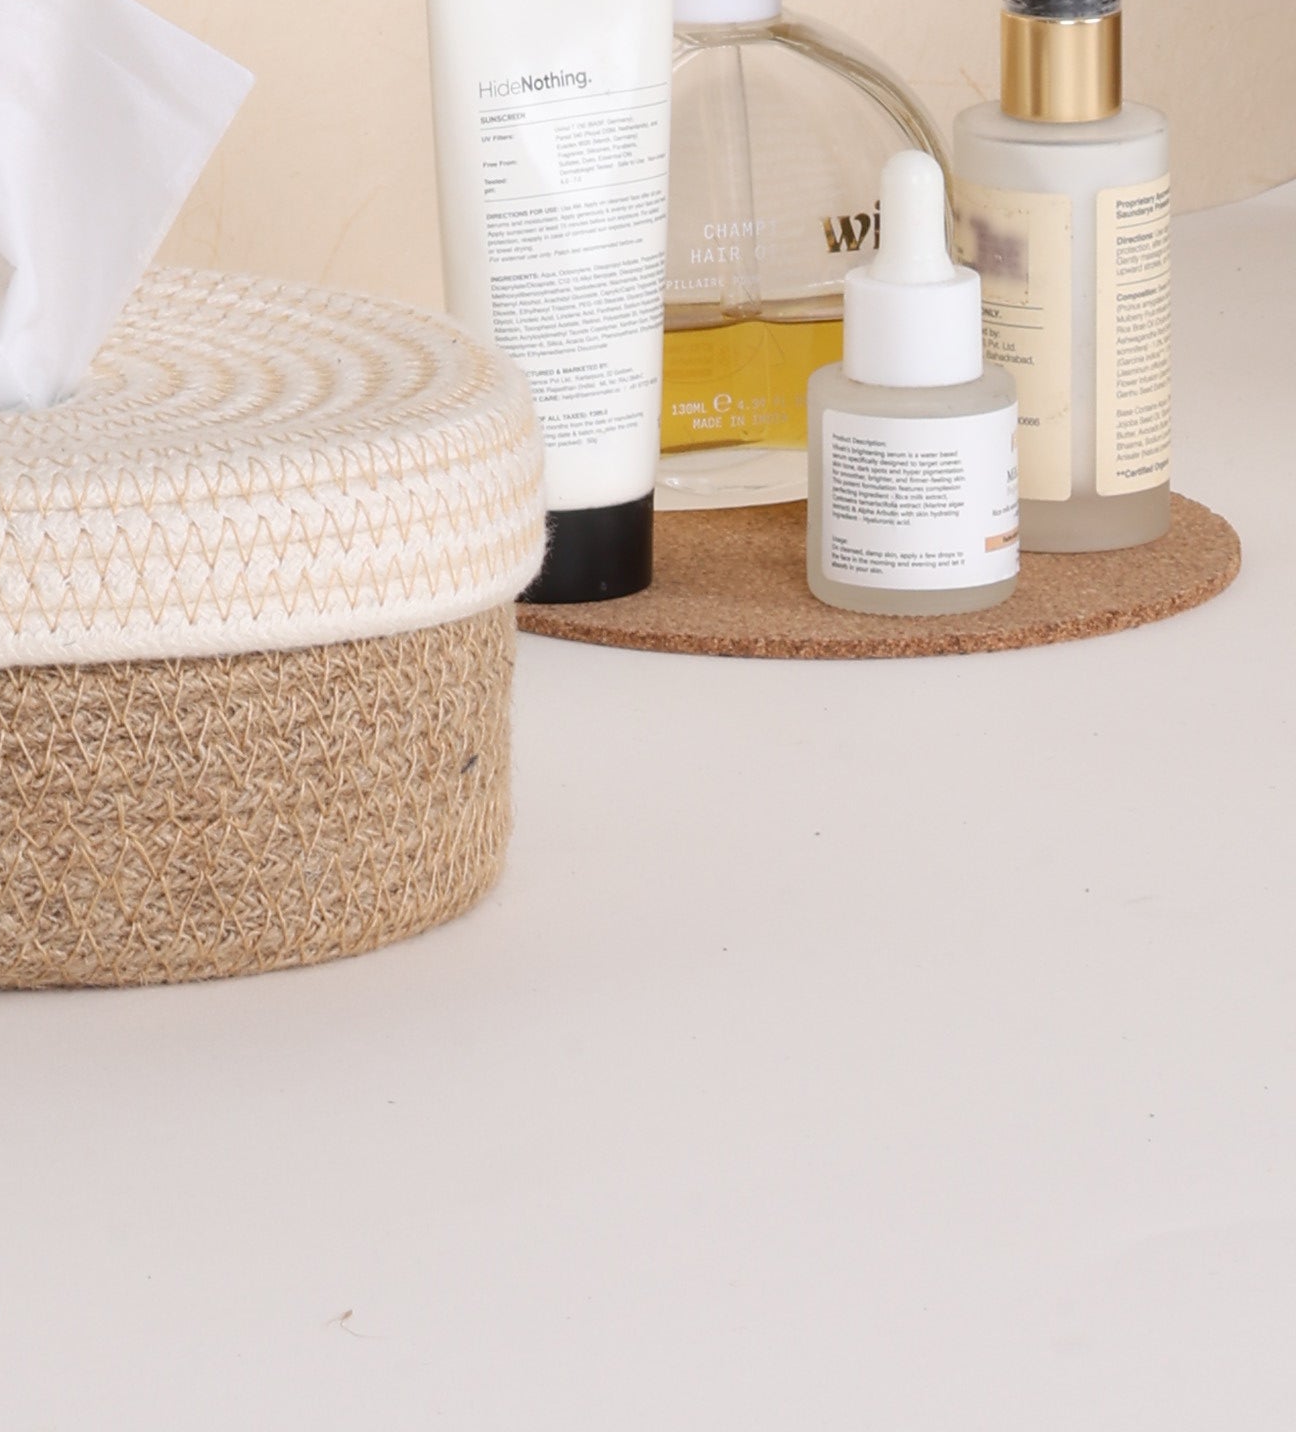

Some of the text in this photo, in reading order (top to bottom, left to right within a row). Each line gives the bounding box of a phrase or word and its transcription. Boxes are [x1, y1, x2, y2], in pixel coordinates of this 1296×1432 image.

[479, 69, 592, 99] HideNothing.
[823, 200, 880, 253] wi
[690, 246, 741, 264] HAIR
[666, 277, 725, 290] PILLAIRE
[692, 416, 722, 429] MADE
